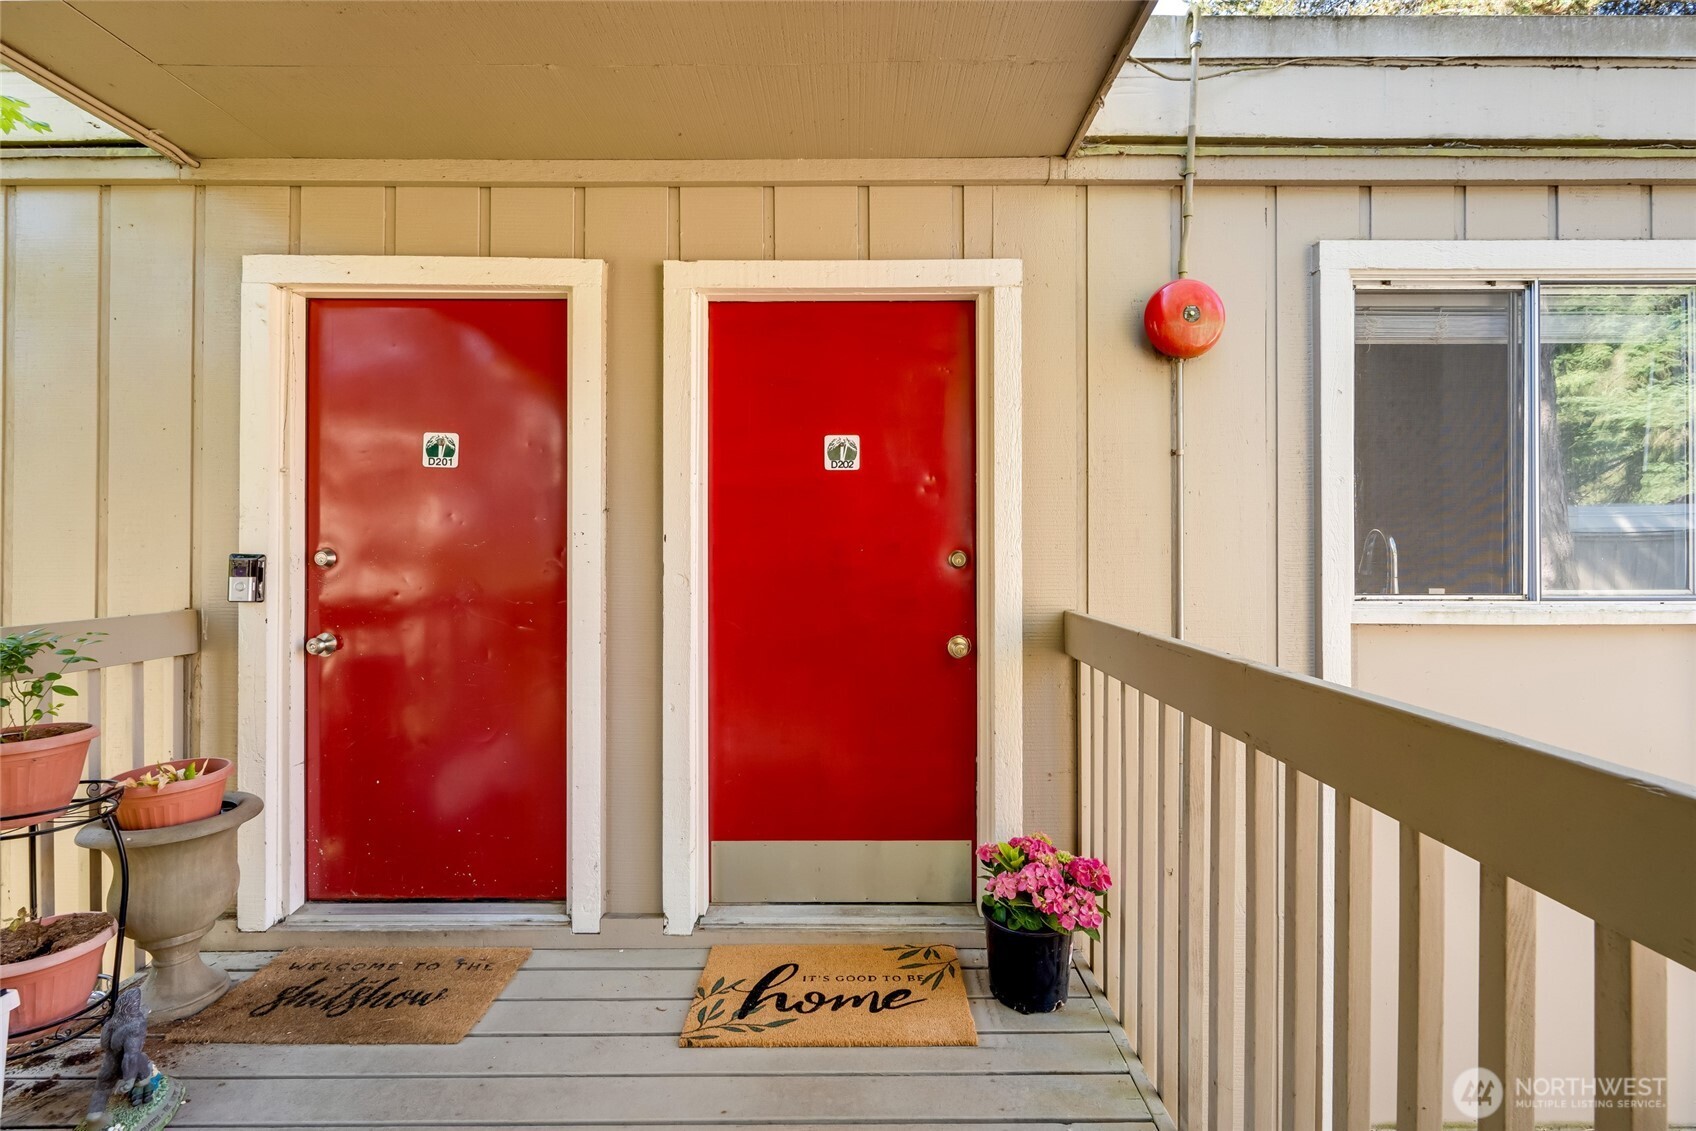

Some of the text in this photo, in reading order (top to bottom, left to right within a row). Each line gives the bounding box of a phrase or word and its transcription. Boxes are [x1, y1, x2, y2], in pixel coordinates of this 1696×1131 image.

[428, 457, 453, 467] D201
[831, 460, 854, 469] D202
[288, 959, 494, 972] WELCOME TO THE
[802, 974, 925, 982] IT'S GOOD TO BE
[737, 962, 928, 1020] home
